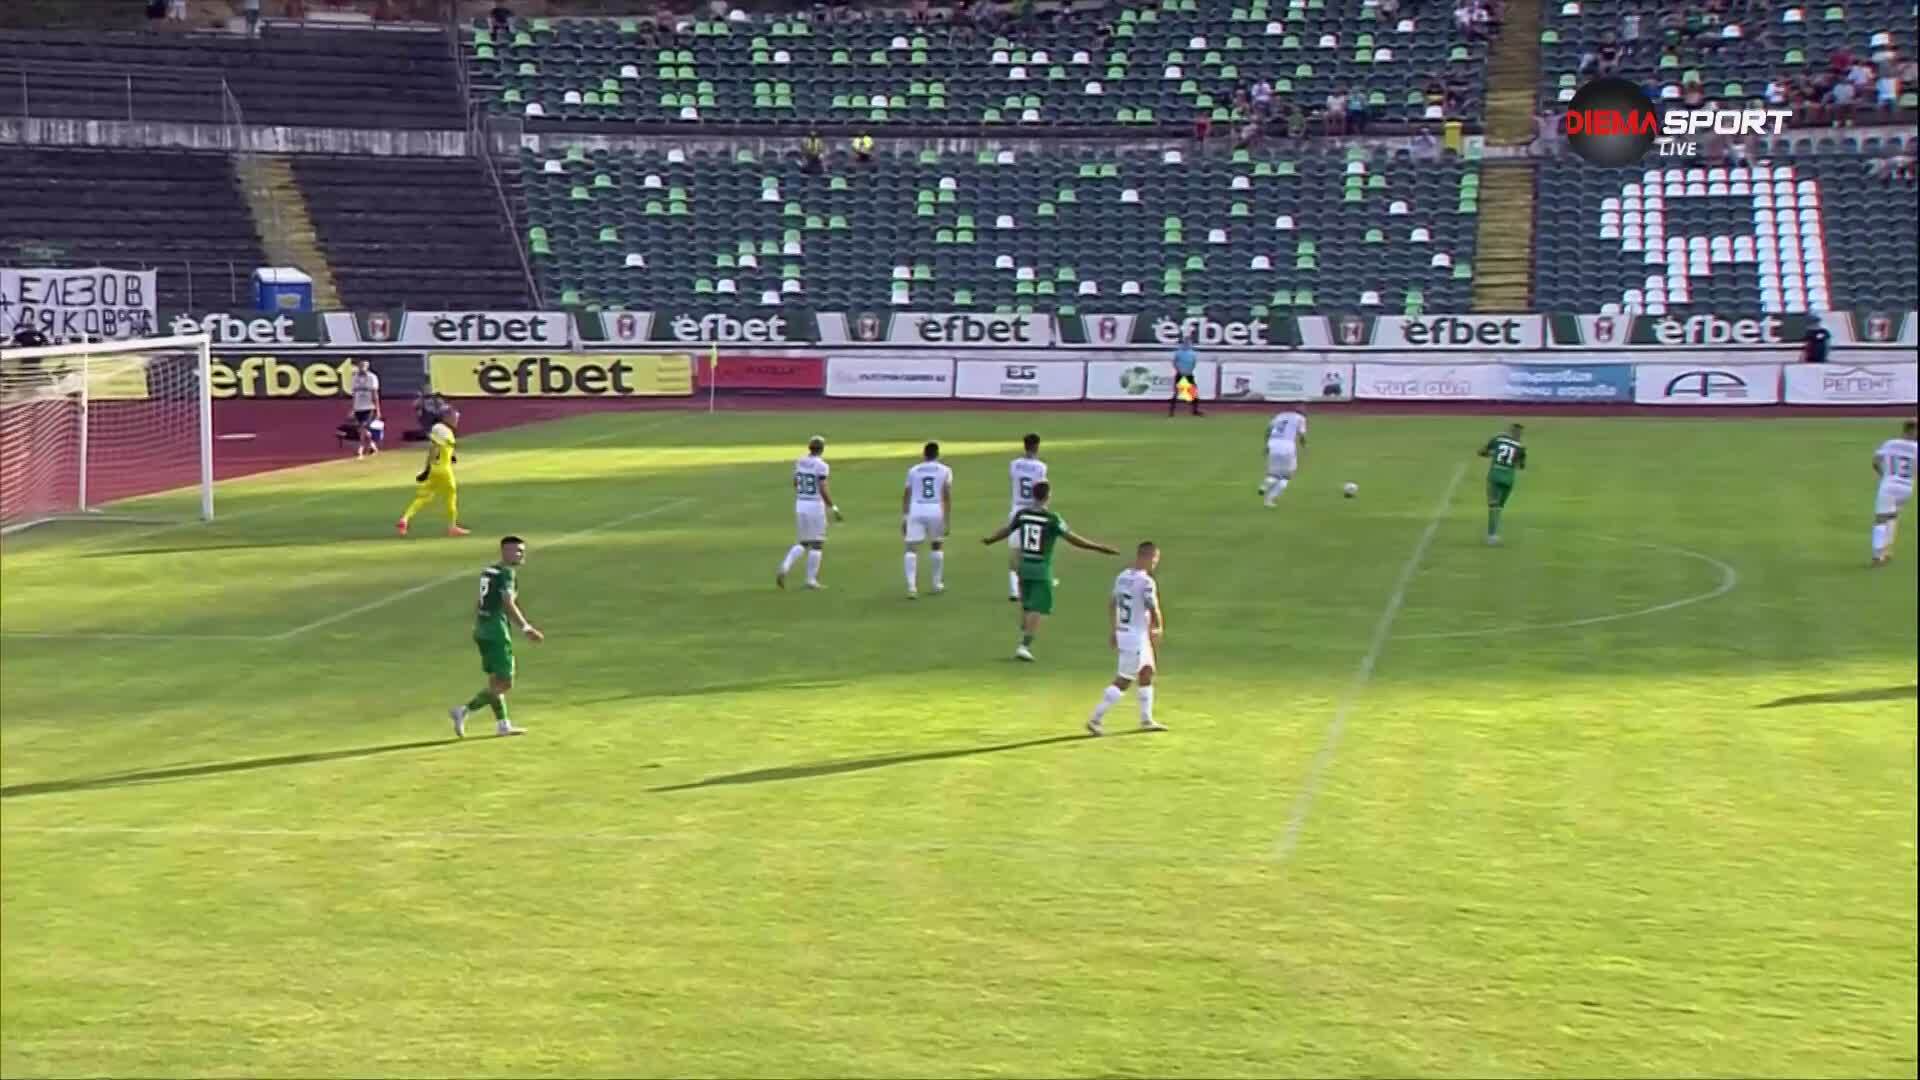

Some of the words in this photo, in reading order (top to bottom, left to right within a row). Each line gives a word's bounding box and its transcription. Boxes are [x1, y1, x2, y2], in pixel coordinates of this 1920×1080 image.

[170, 313, 294, 343] efbet
[429, 314, 548, 342] efbet
[670, 313, 787, 342] efbet
[916, 314, 1031, 343] efbet
[1152, 315, 1268, 345] efbet
[1401, 317, 1521, 345] efbet
[1653, 314, 1783, 344] efbet
[210, 356, 354, 397] efbet
[474, 358, 635, 395] efbet
[1496, 444, 1516, 464] 21
[922, 476, 936, 499] 8
[1020, 477, 1033, 499] 6
[1023, 523, 1042, 552] 19
